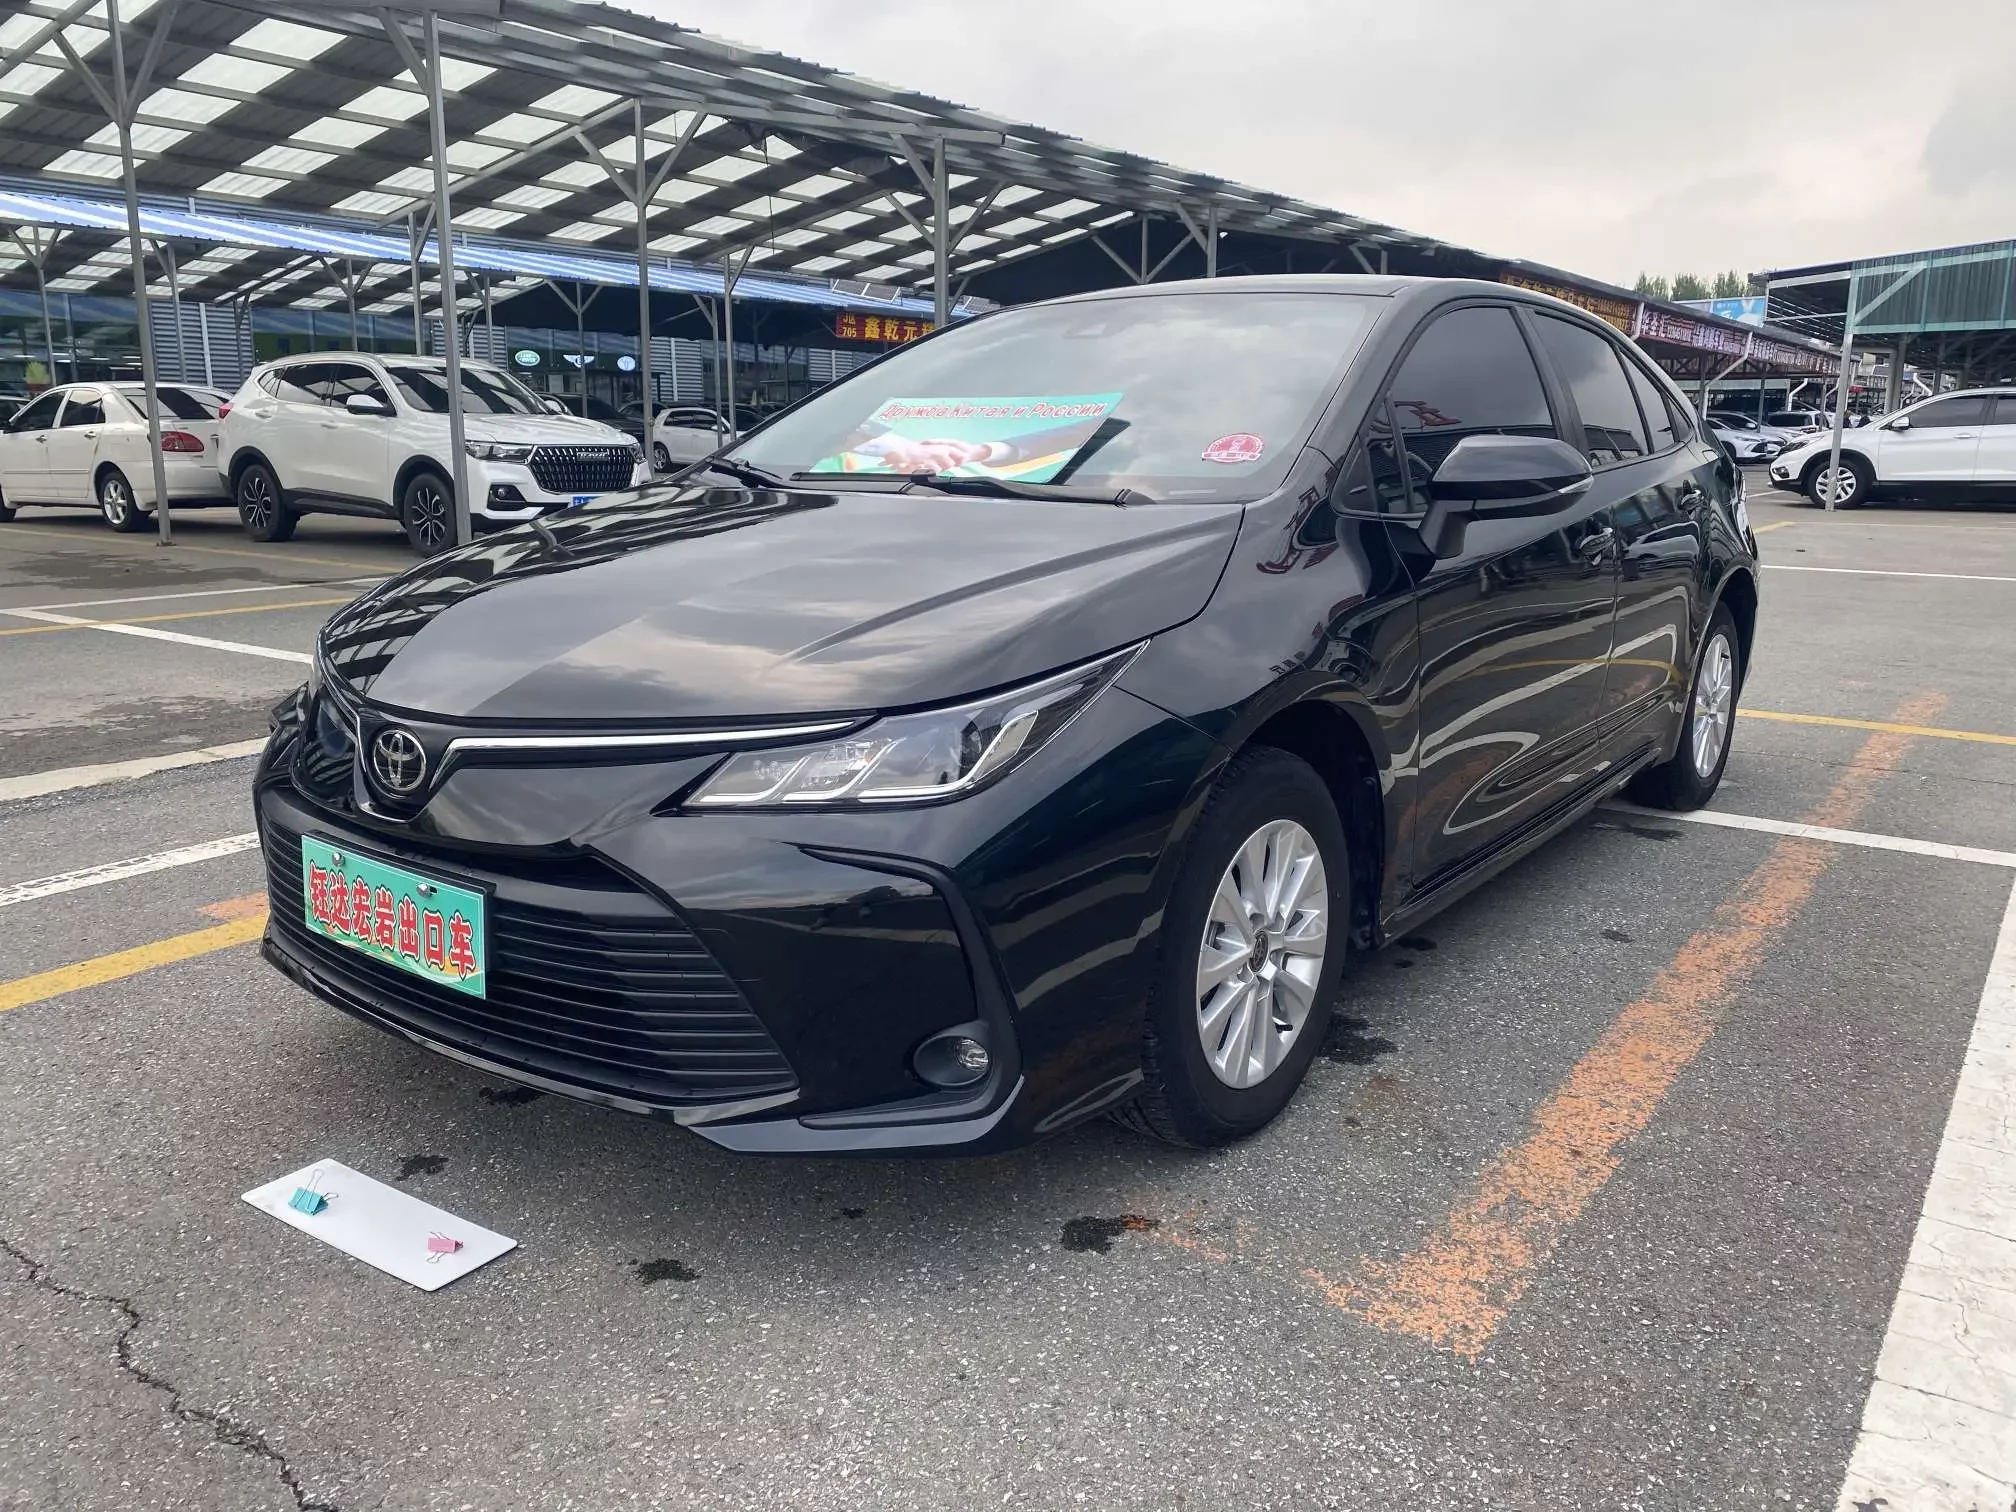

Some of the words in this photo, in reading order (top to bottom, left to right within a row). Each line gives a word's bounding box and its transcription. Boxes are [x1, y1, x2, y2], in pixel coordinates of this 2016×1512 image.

[842, 327, 857, 338] 705
[1013, 405, 1029, 418] и
[1029, 402, 1108, 419] России
